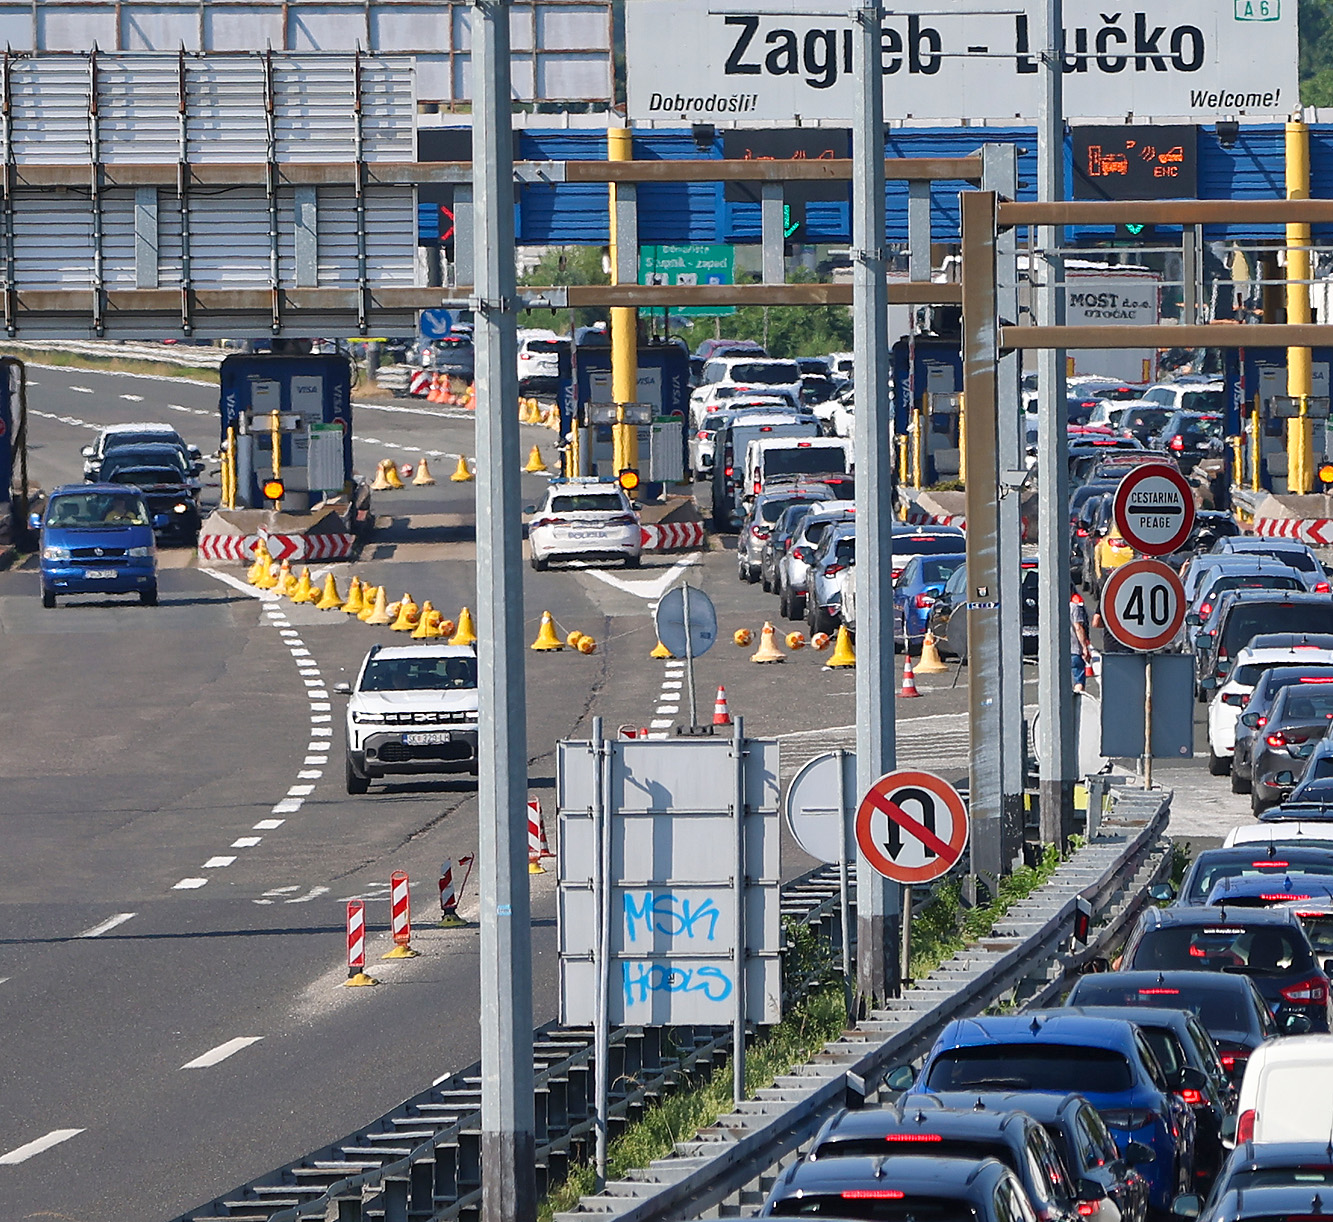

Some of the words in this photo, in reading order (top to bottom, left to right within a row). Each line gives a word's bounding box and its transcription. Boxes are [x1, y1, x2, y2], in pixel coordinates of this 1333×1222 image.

[1243, 0, 1254, 17] A
[1259, 0, 1269, 17] 6
[724, 15, 943, 89] Zagreb
[1015, 12, 1205, 74] Lučko
[649, 93, 758, 112] Dobrodošli!
[1189, 89, 1281, 108] Welcome!
[1070, 293, 1119, 308] MOST
[1131, 491, 1179, 504] CESTARINA
[1140, 516, 1171, 529] PEAGE
[1122, 584, 1169, 626] 40
[623, 891, 720, 942] MSK
